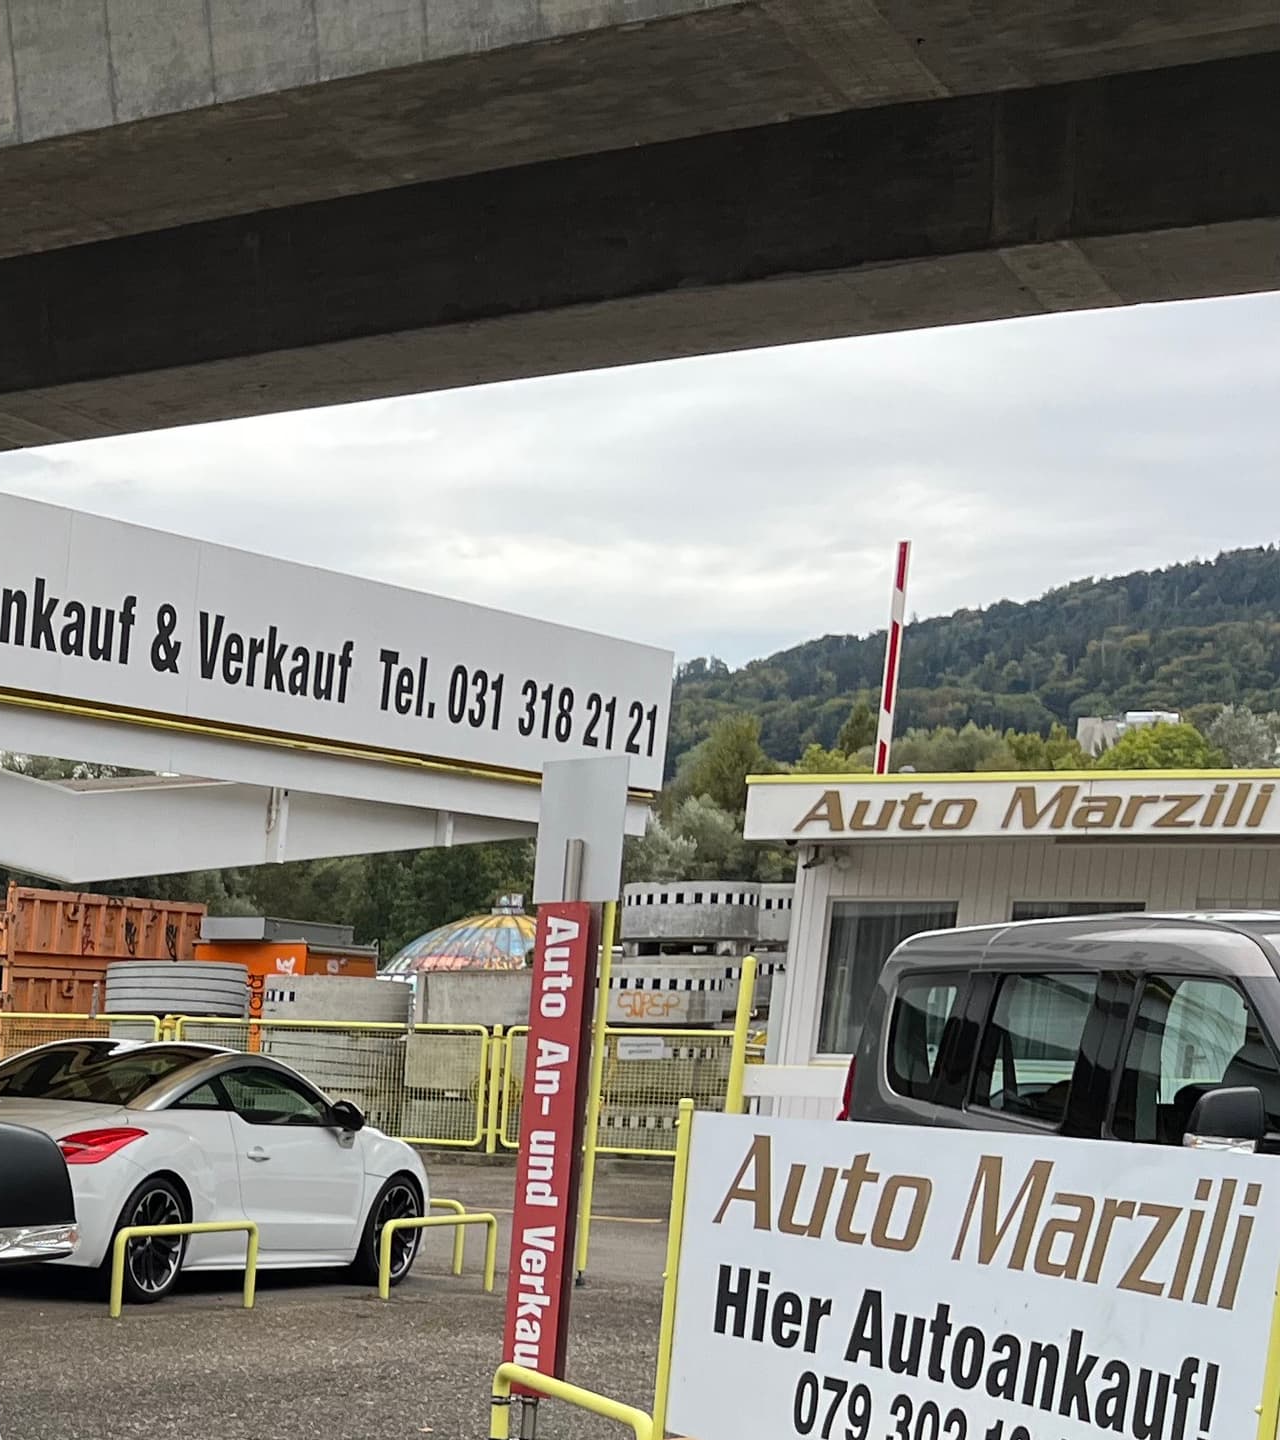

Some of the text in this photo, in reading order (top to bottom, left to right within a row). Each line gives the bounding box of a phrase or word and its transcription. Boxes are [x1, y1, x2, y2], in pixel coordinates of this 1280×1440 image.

[151, 603, 182, 674] &
[199, 611, 354, 703] Verkauf
[380, 649, 435, 719] Tel.
[448, 664, 504, 730] 031
[518, 679, 574, 743] 318
[582, 693, 617, 750] 21
[624, 701, 658, 757] 21
[793, 783, 1276, 831] Auto Marzili
[513, 916, 579, 1370] Auto An- und Verkau
[712, 1134, 1262, 1311] Auto Marzili
[713, 1264, 832, 1354] Hier
